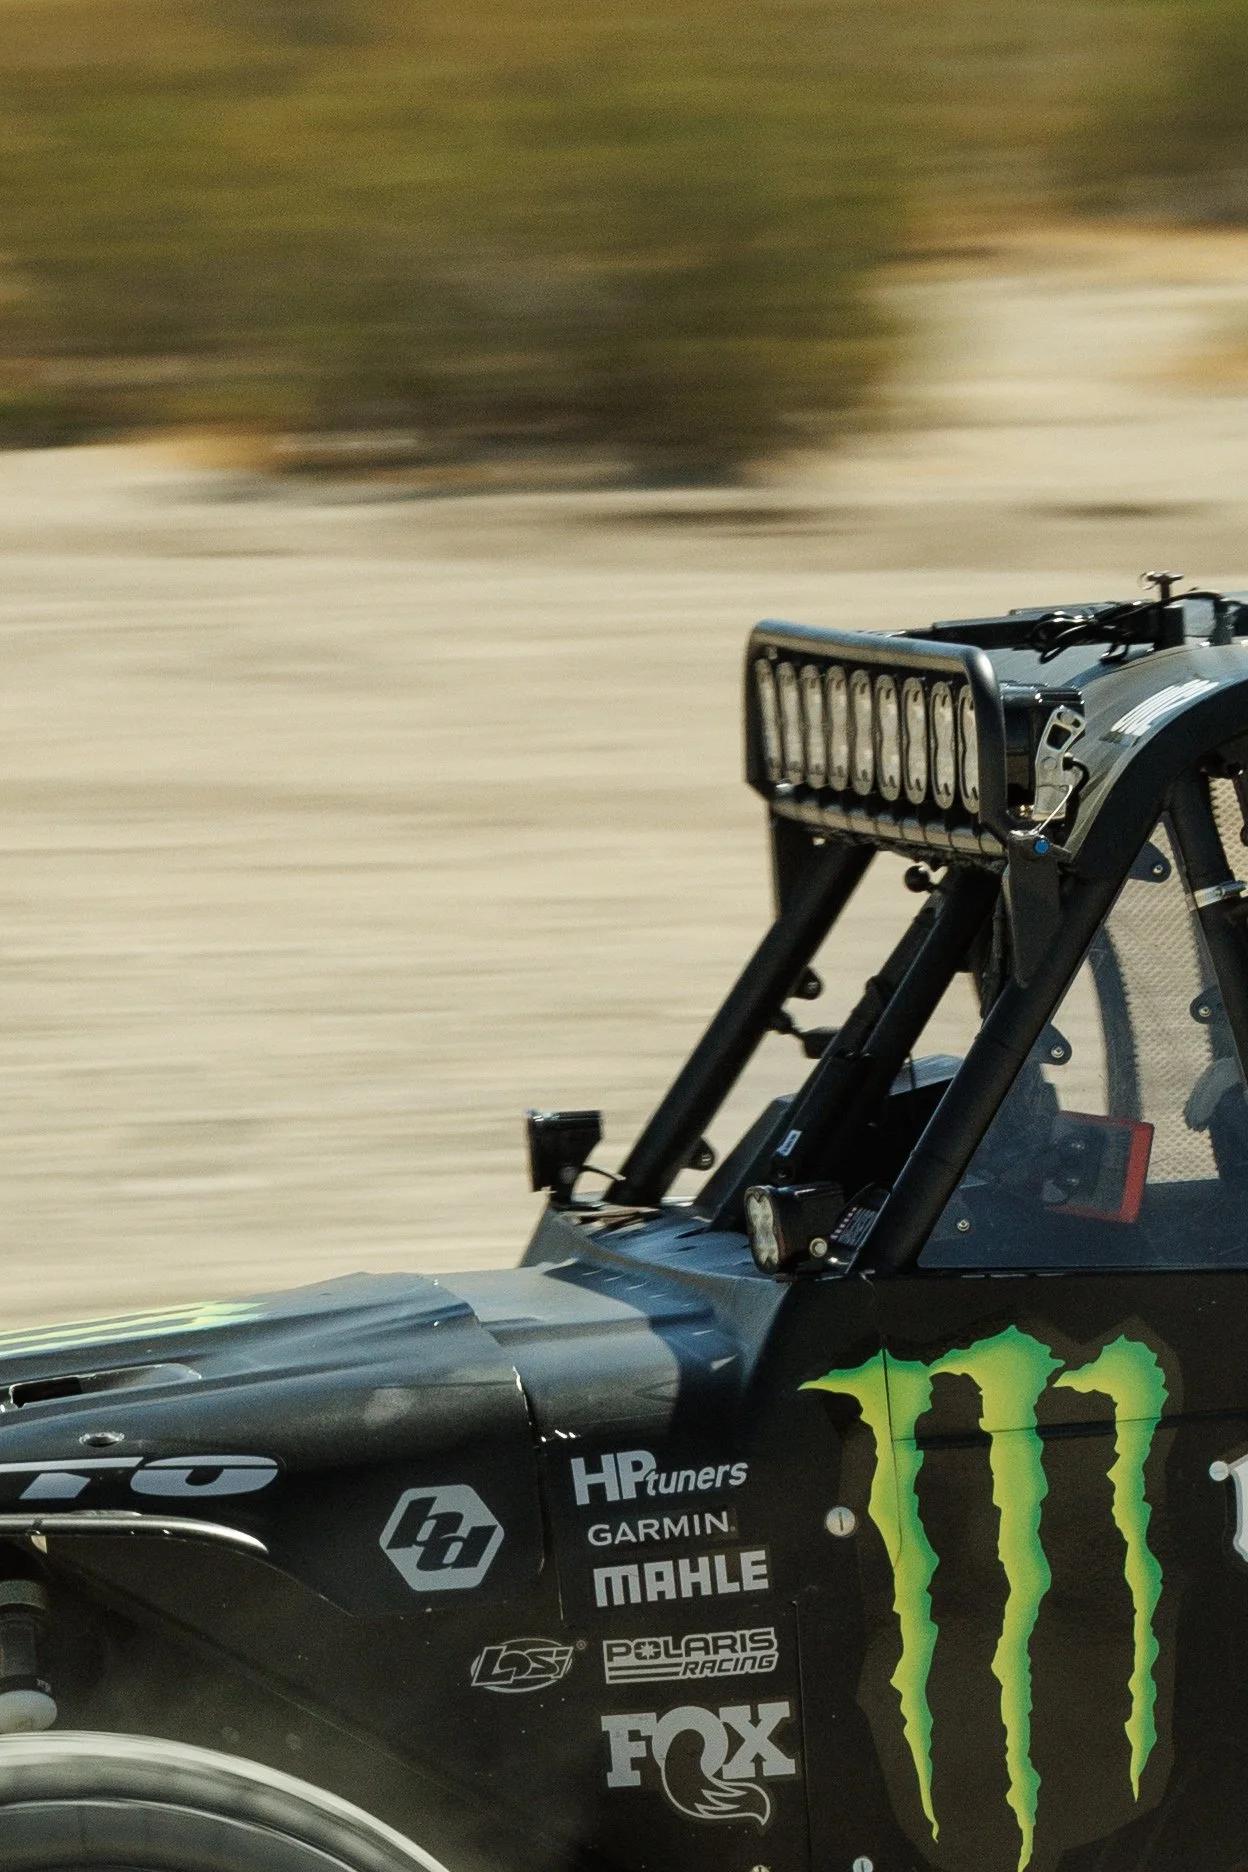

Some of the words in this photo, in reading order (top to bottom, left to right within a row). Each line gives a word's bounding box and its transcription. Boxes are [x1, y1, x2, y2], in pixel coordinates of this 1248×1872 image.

[588, 1511, 730, 1546] GARMIN
[593, 1550, 770, 1608] MAHLE
[605, 1629, 776, 1663] POLARIS
[681, 1653, 777, 1677] RACING
[600, 1701, 797, 1825] FOX
